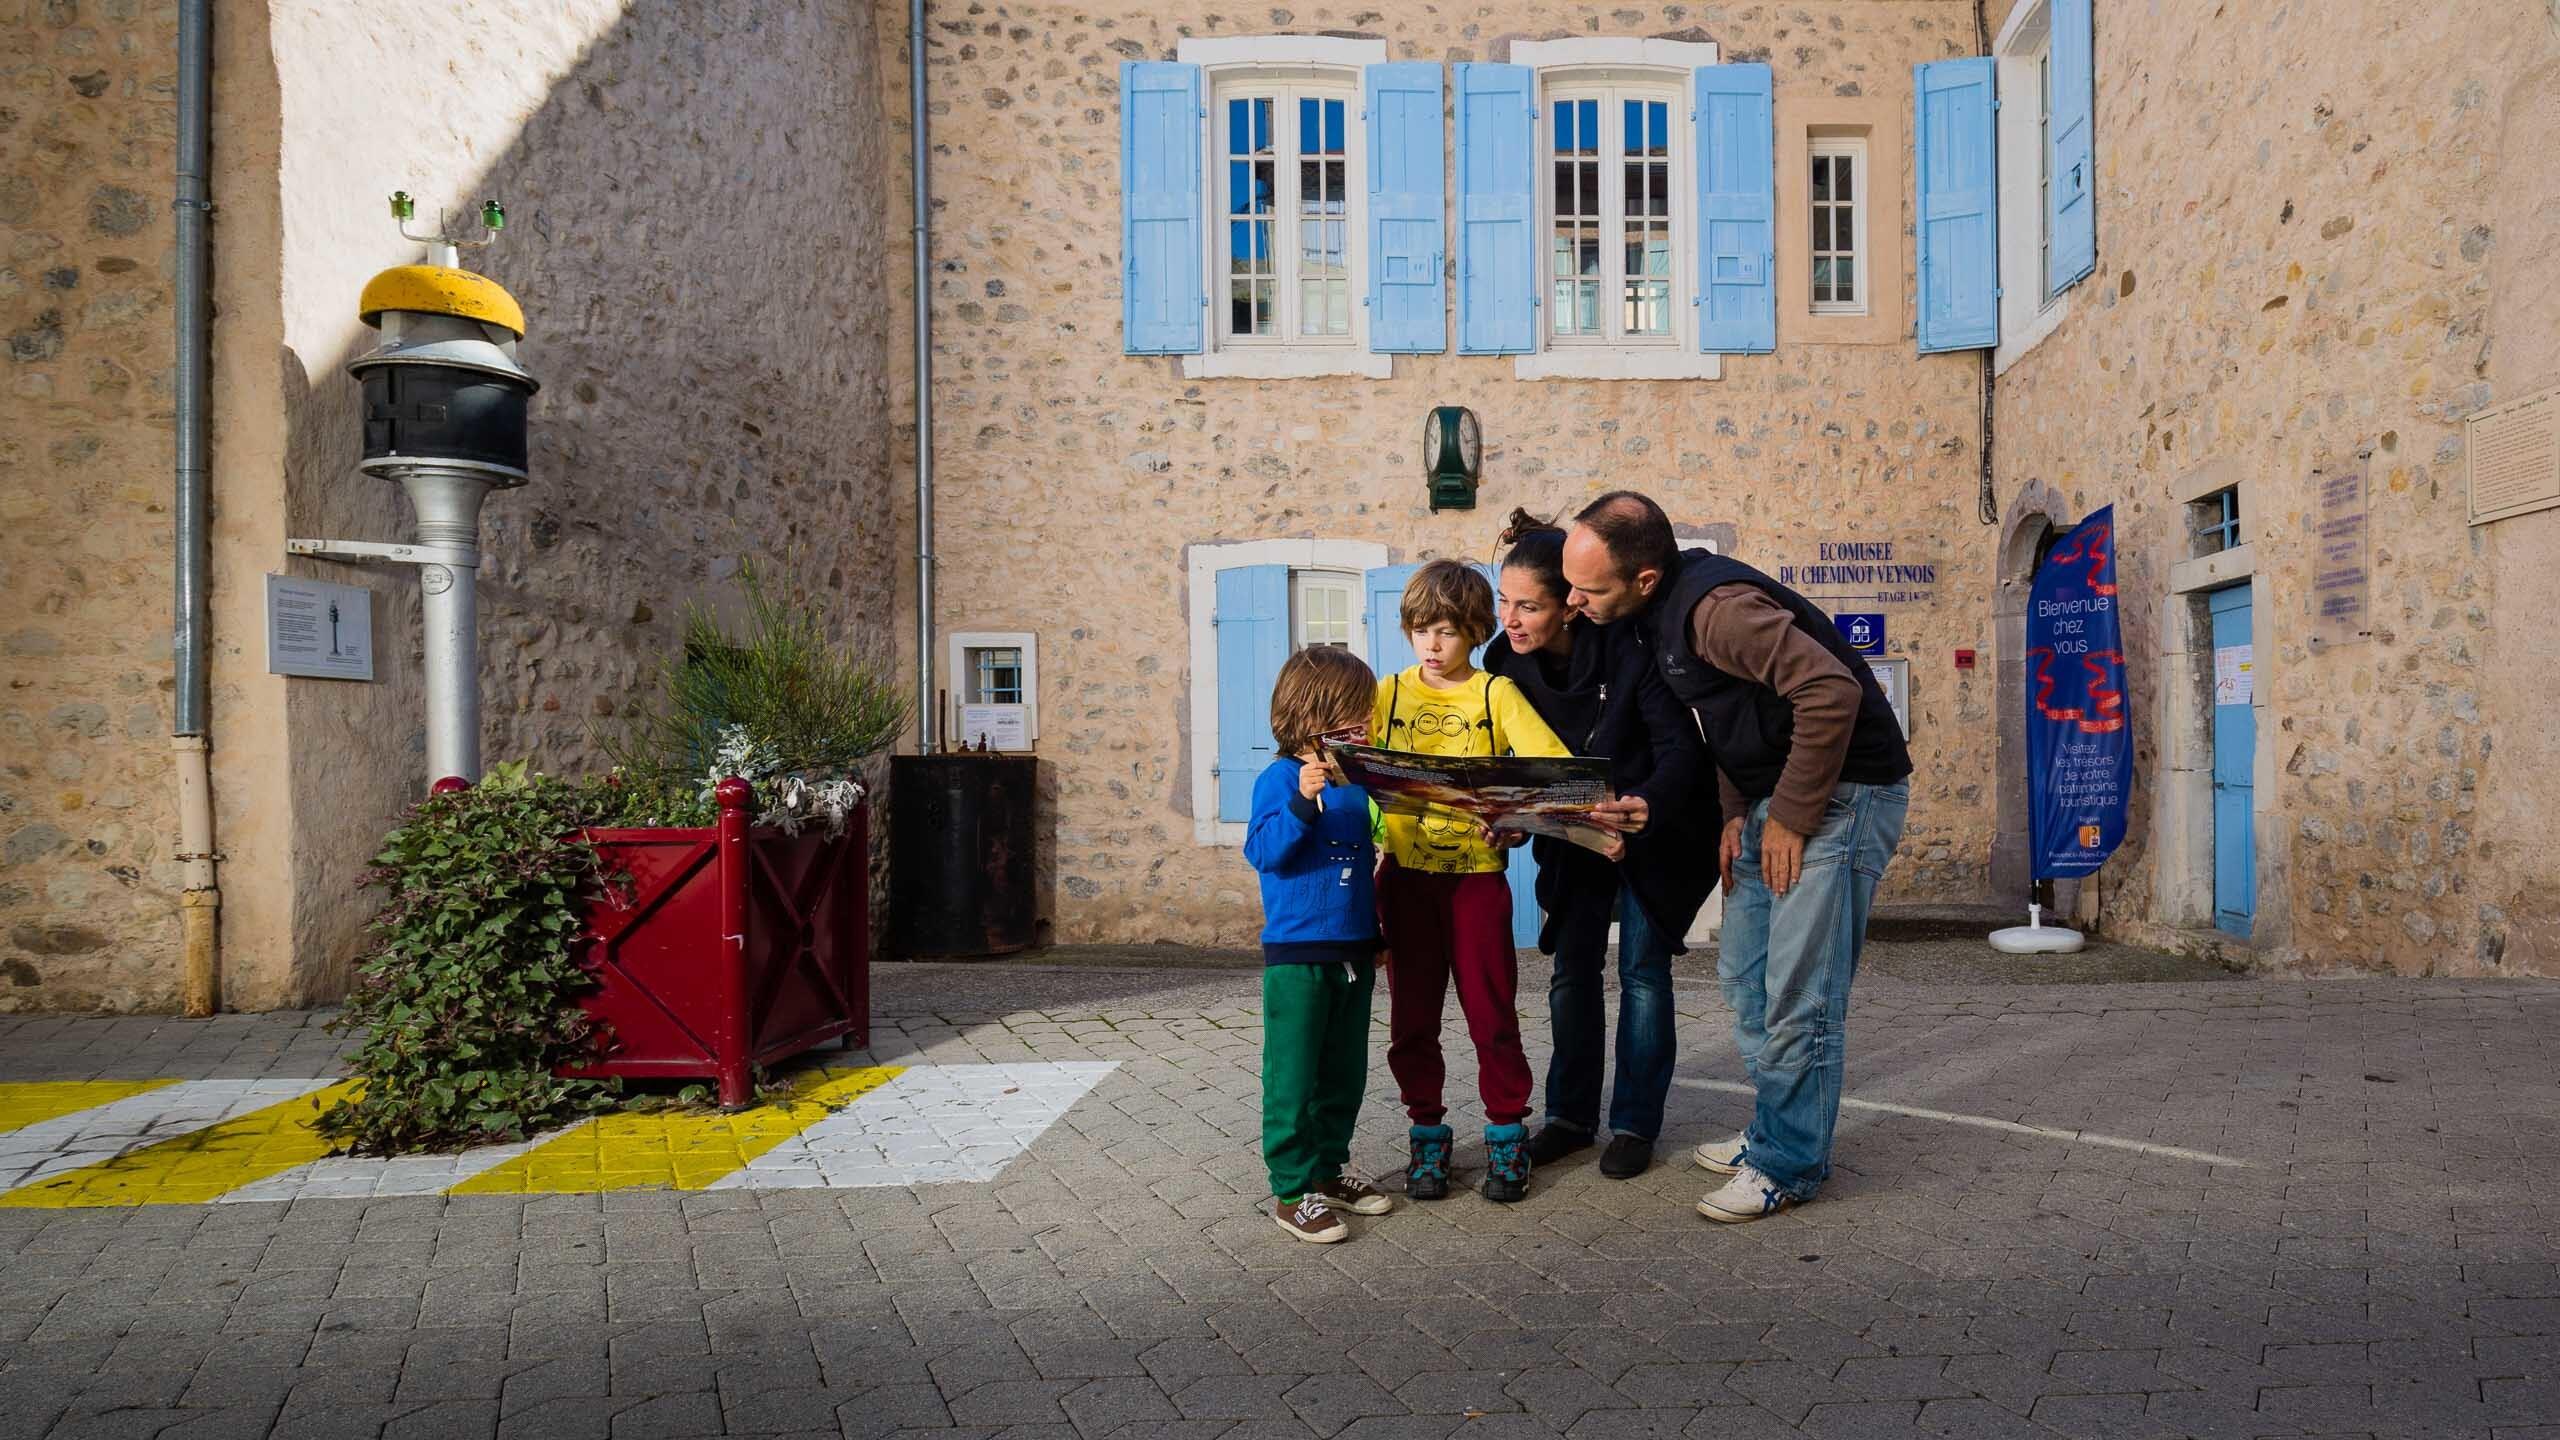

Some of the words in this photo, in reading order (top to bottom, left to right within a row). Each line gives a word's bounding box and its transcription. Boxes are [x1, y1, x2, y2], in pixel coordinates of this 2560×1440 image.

[1819, 542, 1893, 561] ECOMUSEE
[1780, 565, 1798, 585] DU
[1801, 565, 1873, 584] CHEMINOT
[1876, 564, 1936, 584] VEYNOIS
[1877, 591, 1906, 602] ETAGE
[2038, 596, 2109, 617] Bienvenue
[2053, 618, 2084, 635] chez
[2054, 639, 2089, 655] vous
[2062, 743, 2097, 754] Visitez
[2055, 757, 2071, 768] les
[2074, 755, 2115, 767] trésors
[2064, 770, 2078, 781] de
[2081, 769, 2110, 780] votre
[2059, 781, 2118, 795] patrimoine
[2060, 794, 2118, 808] touristique
